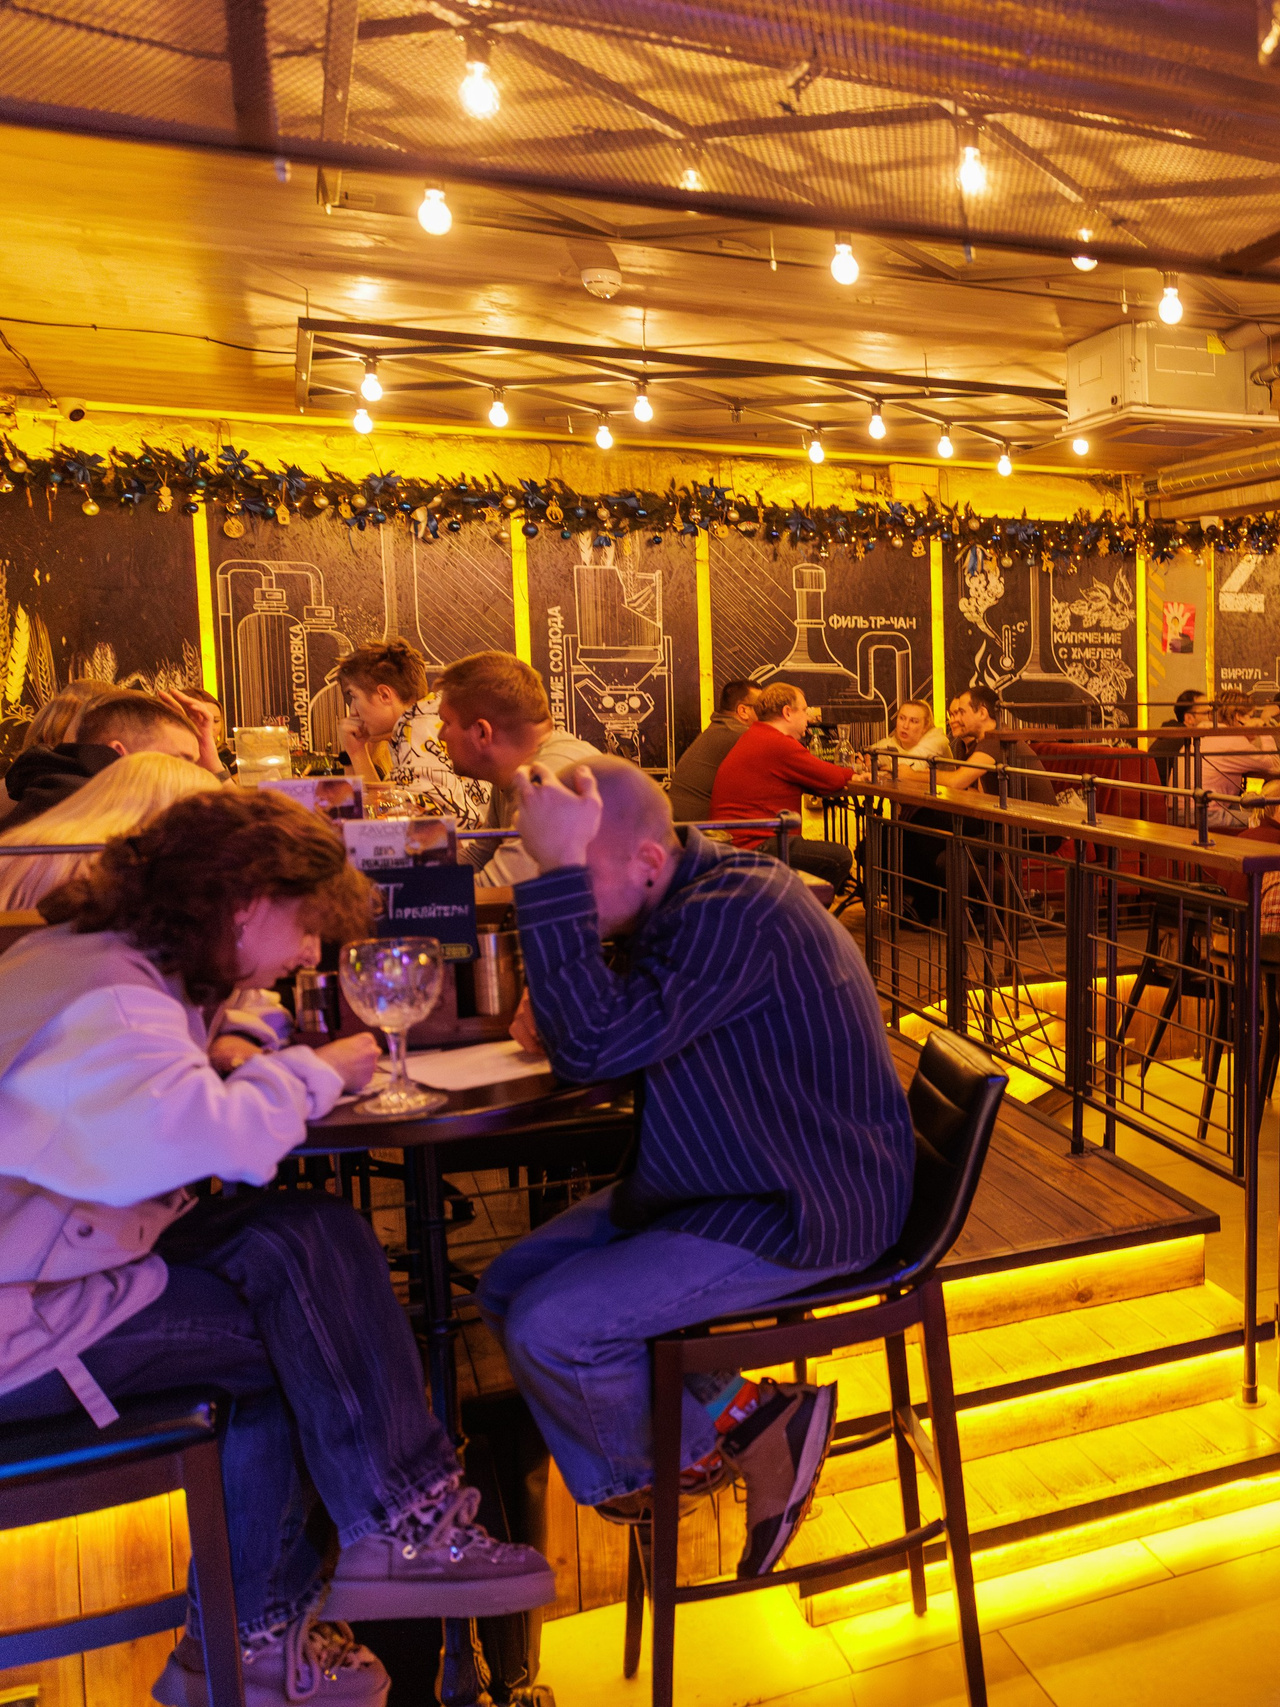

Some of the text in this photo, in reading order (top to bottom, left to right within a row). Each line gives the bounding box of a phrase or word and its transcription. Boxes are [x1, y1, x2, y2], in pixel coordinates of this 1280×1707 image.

[829, 614, 916, 629] ФИЛЬТР-ЧАН
[548, 606, 564, 672] СОЛОДА
[1053, 631, 1121, 644] КИПЯЧЕНИЕ
[1058, 647, 1122, 660] С ХМЕЛЕМ
